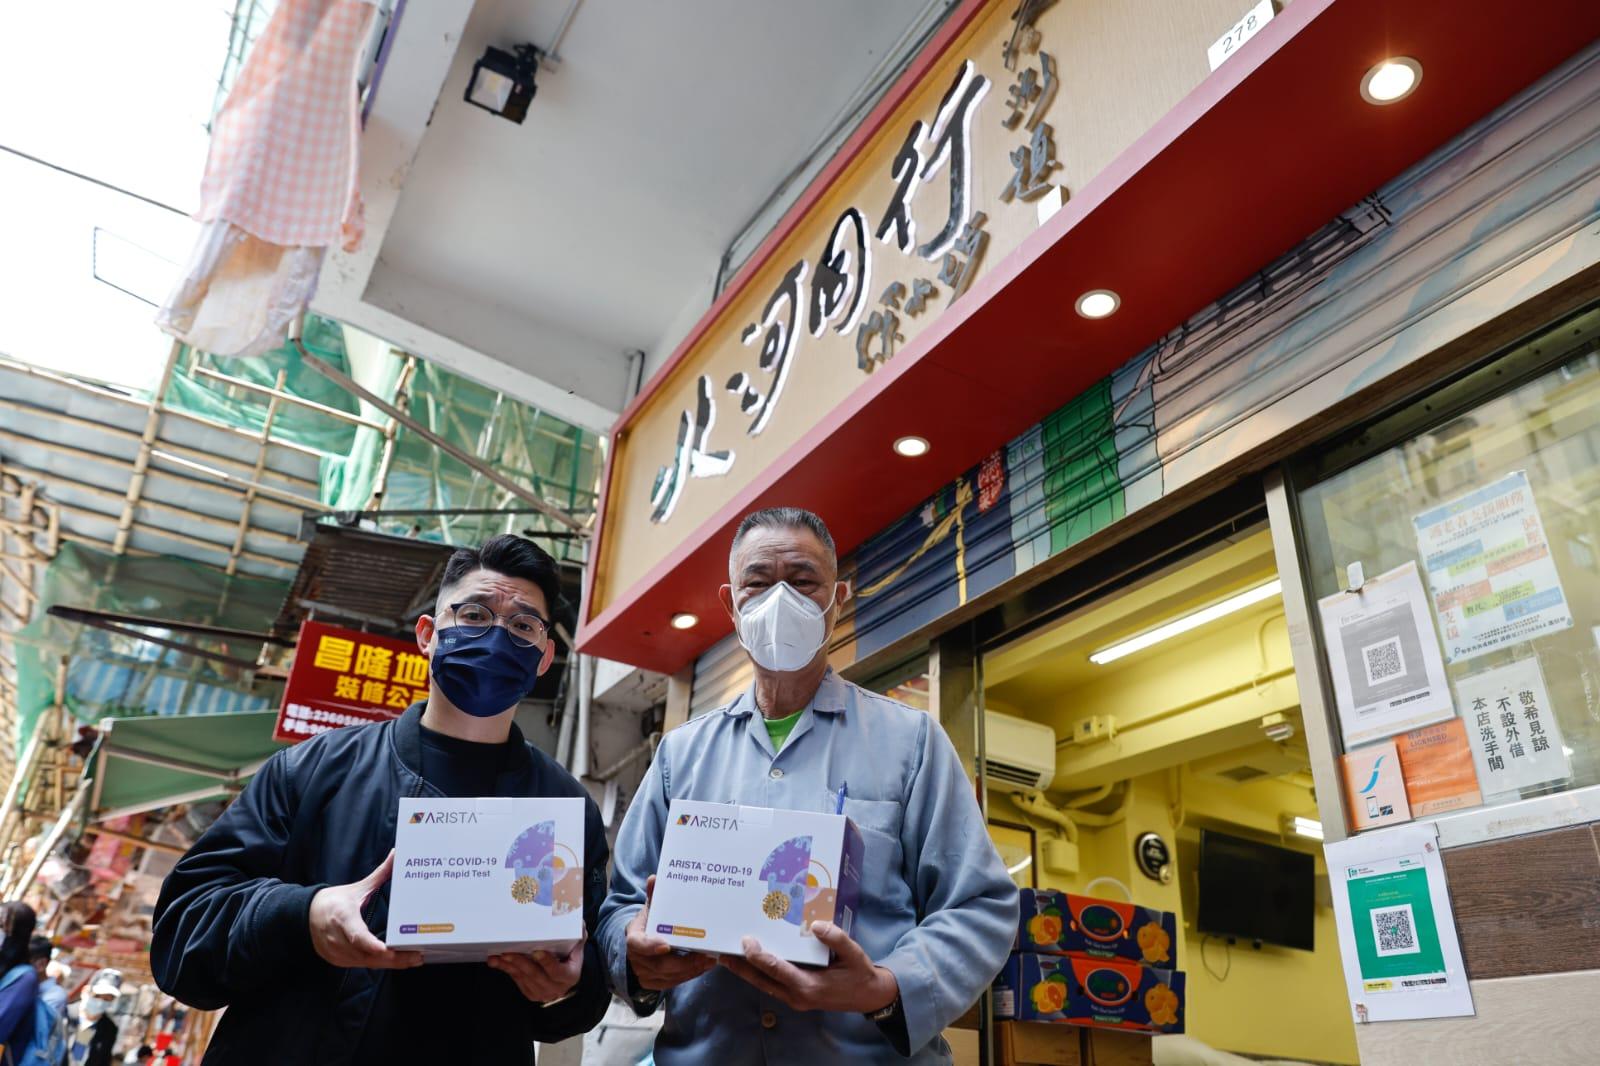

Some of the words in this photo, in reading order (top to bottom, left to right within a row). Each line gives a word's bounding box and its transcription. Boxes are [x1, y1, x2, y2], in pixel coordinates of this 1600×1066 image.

[1222, 15, 1258, 54] 278
[313, 634, 430, 688] 昌隆地
[1471, 696, 1505, 773] 本店洗手間
[1495, 696, 1525, 759] 不設外借
[1517, 689, 1550, 753] 敬希見諒
[404, 870, 441, 881] Antigen
[443, 869, 470, 879] Rapid
[472, 868, 491, 878] Test
[448, 856, 498, 867] COVID-19
[666, 871, 699, 883] Antigen
[700, 874, 726, 887] Rapid
[727, 877, 745, 888] Test
[706, 862, 753, 876] COVID-19
